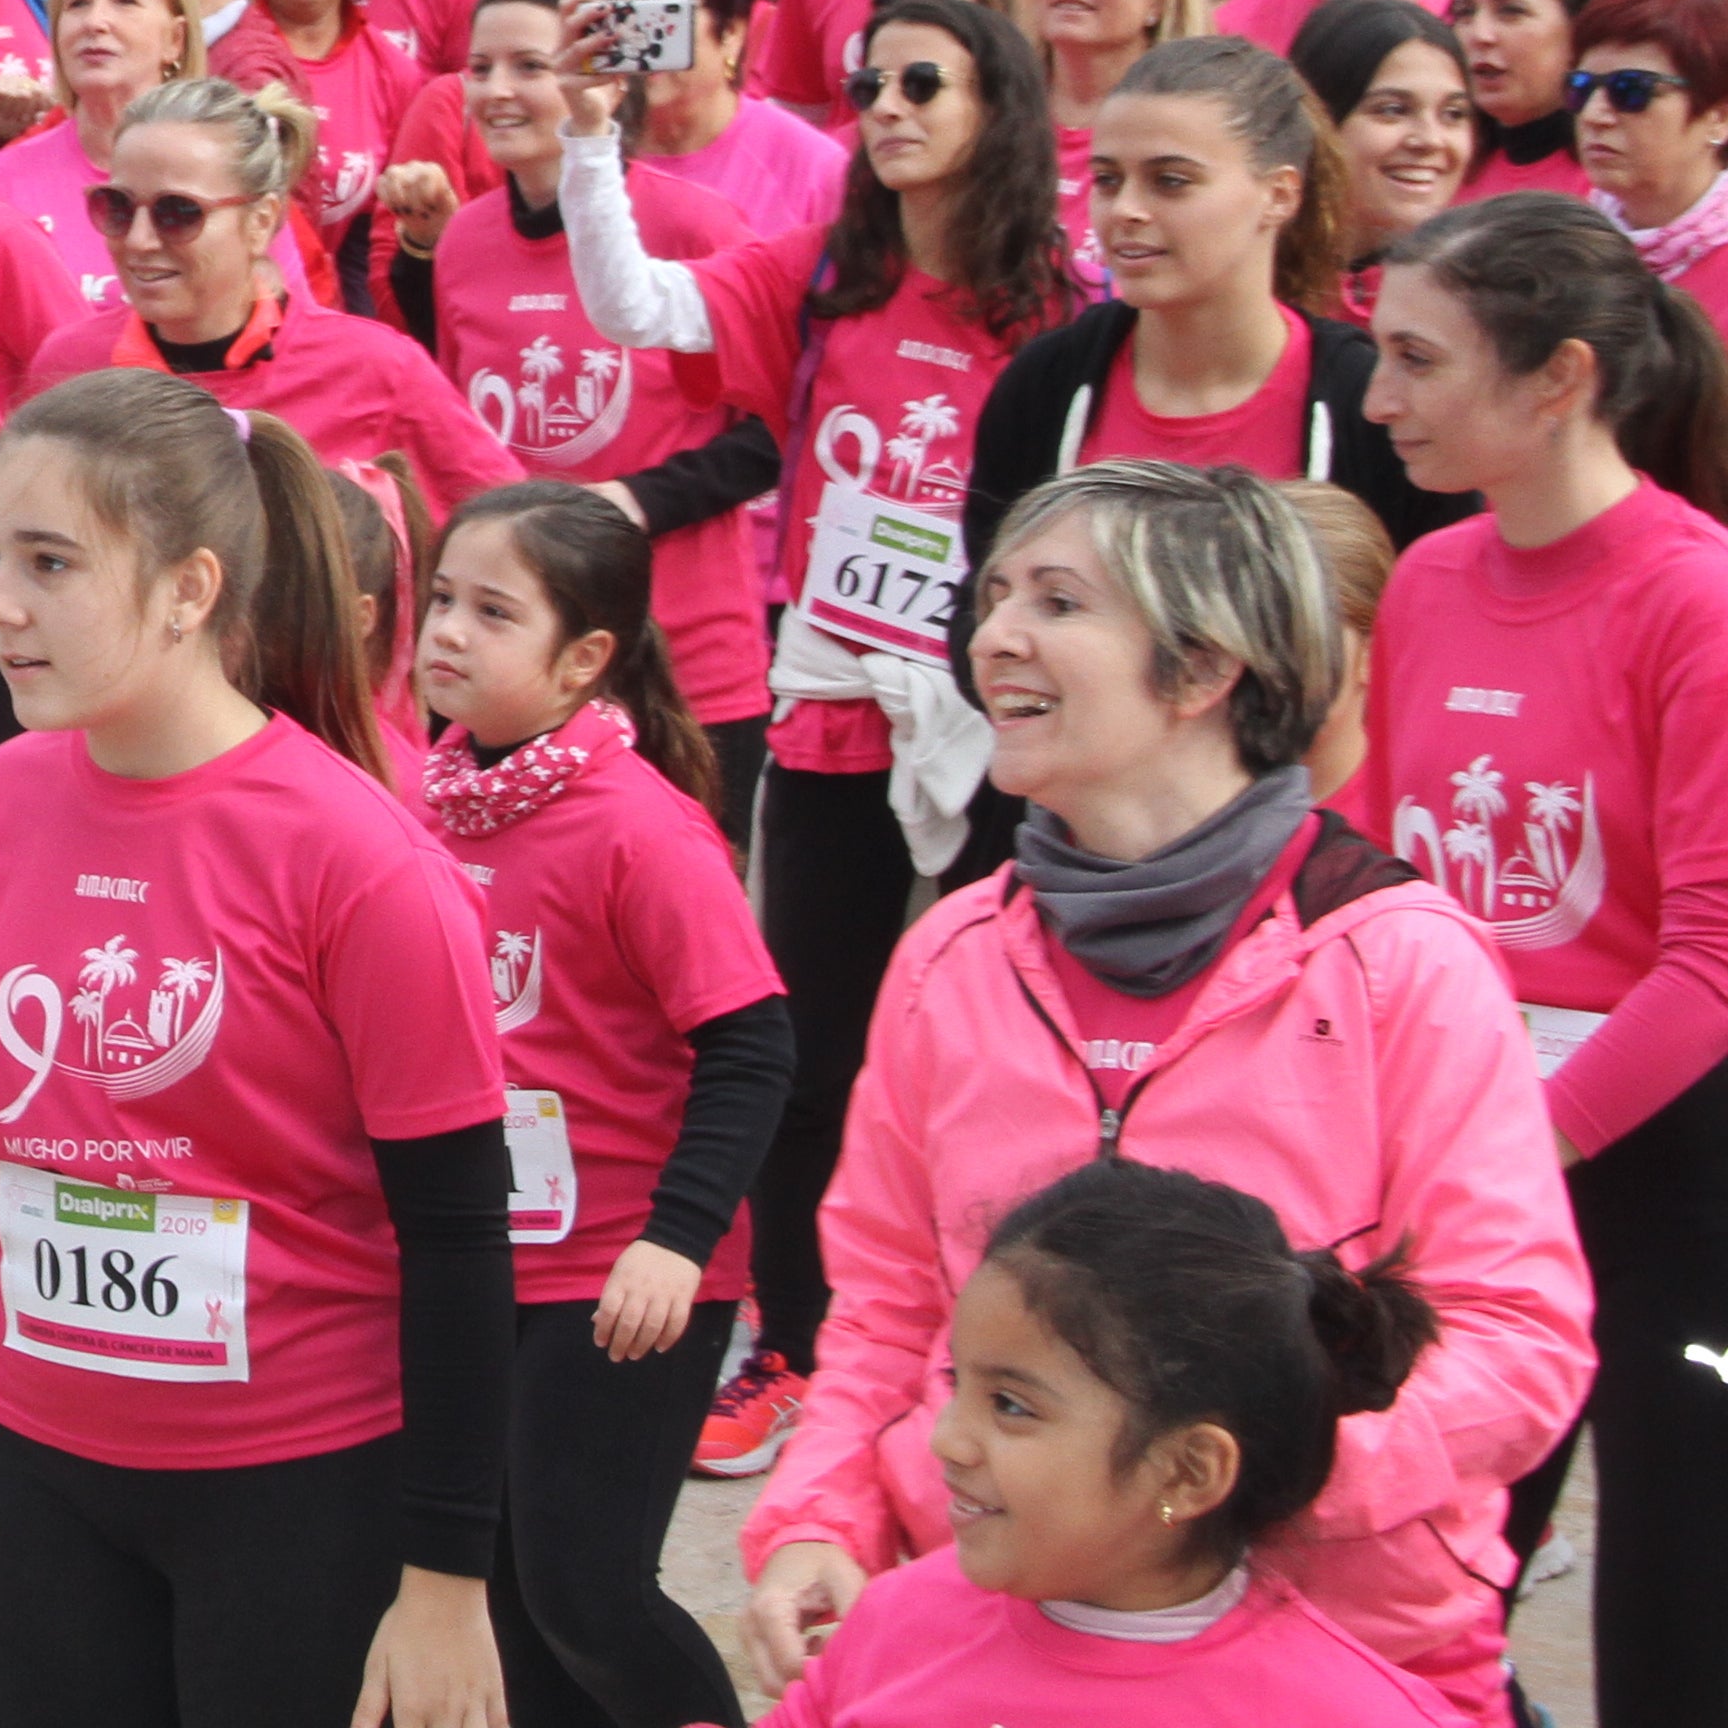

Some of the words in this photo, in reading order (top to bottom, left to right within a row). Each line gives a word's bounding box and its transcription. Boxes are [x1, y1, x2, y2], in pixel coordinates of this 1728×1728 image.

[835, 554, 960, 628] 6172
[74, 873, 150, 905] AMACMEC
[503, 1117, 538, 1136] 2019
[84, 1139, 134, 1162] POR
[134, 1136, 194, 1160] VIVIR
[59, 1191, 150, 1222] Dialprix
[160, 1216, 208, 1236] 2019
[34, 1238, 180, 1318] 0186
